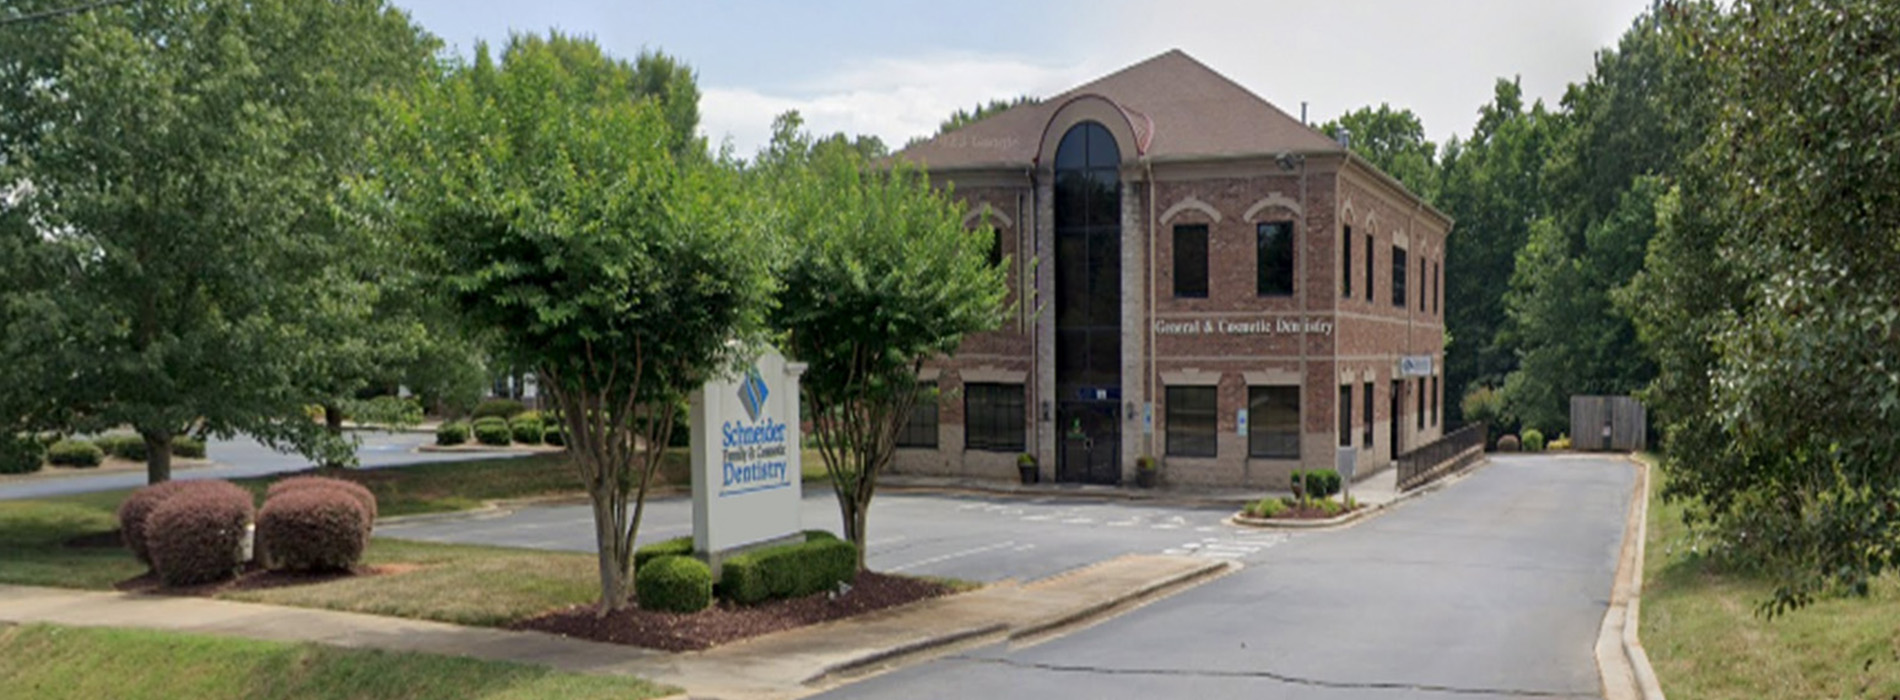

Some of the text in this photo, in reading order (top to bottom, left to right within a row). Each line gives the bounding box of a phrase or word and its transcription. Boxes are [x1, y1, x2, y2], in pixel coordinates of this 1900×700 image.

[1155, 318, 1333, 336] General & Cosmetic Denistry
[723, 417, 787, 448] Schneider
[723, 448, 747, 462] Family
[723, 461, 787, 487] Dentistry
